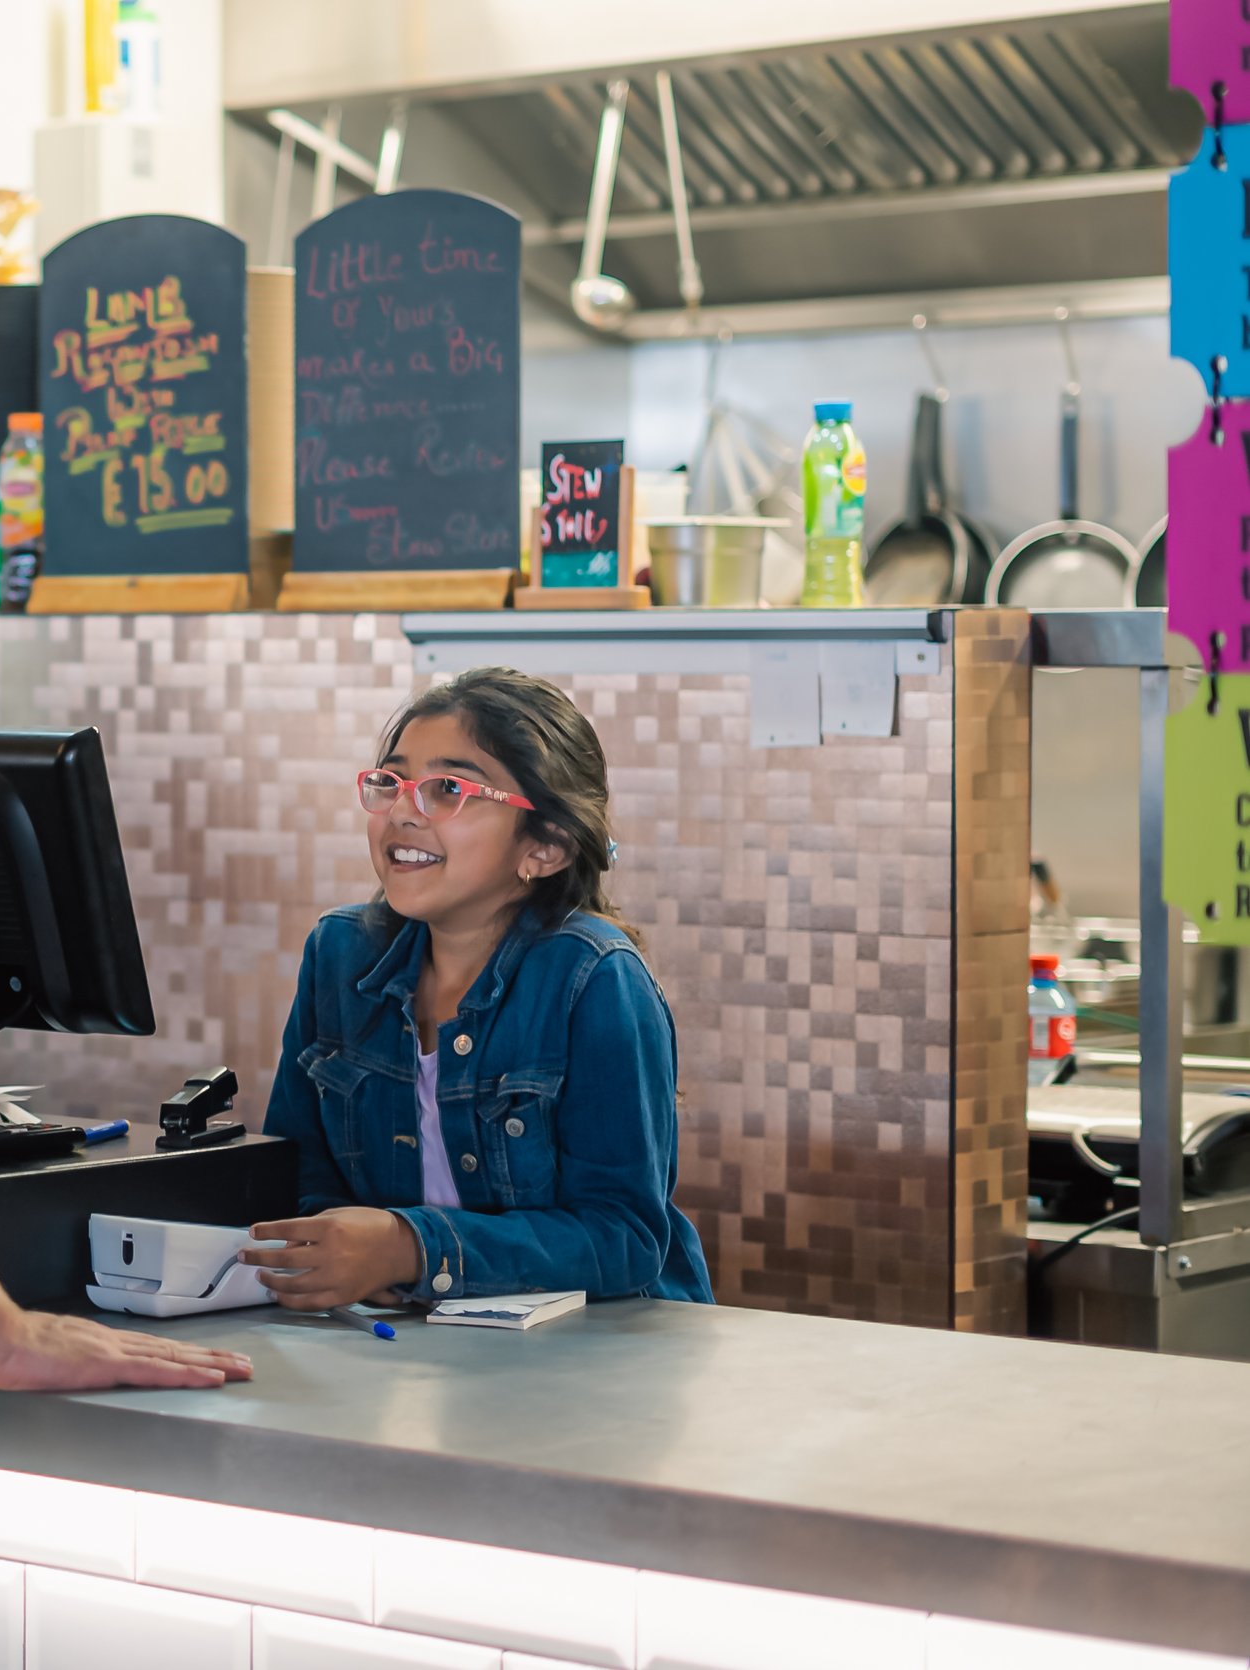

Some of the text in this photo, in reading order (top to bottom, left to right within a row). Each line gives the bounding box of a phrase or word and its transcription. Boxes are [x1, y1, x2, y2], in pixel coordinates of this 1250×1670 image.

[306, 219, 505, 299] Little time
[85, 274, 188, 330] LAMB
[546, 453, 602, 505] STEW
